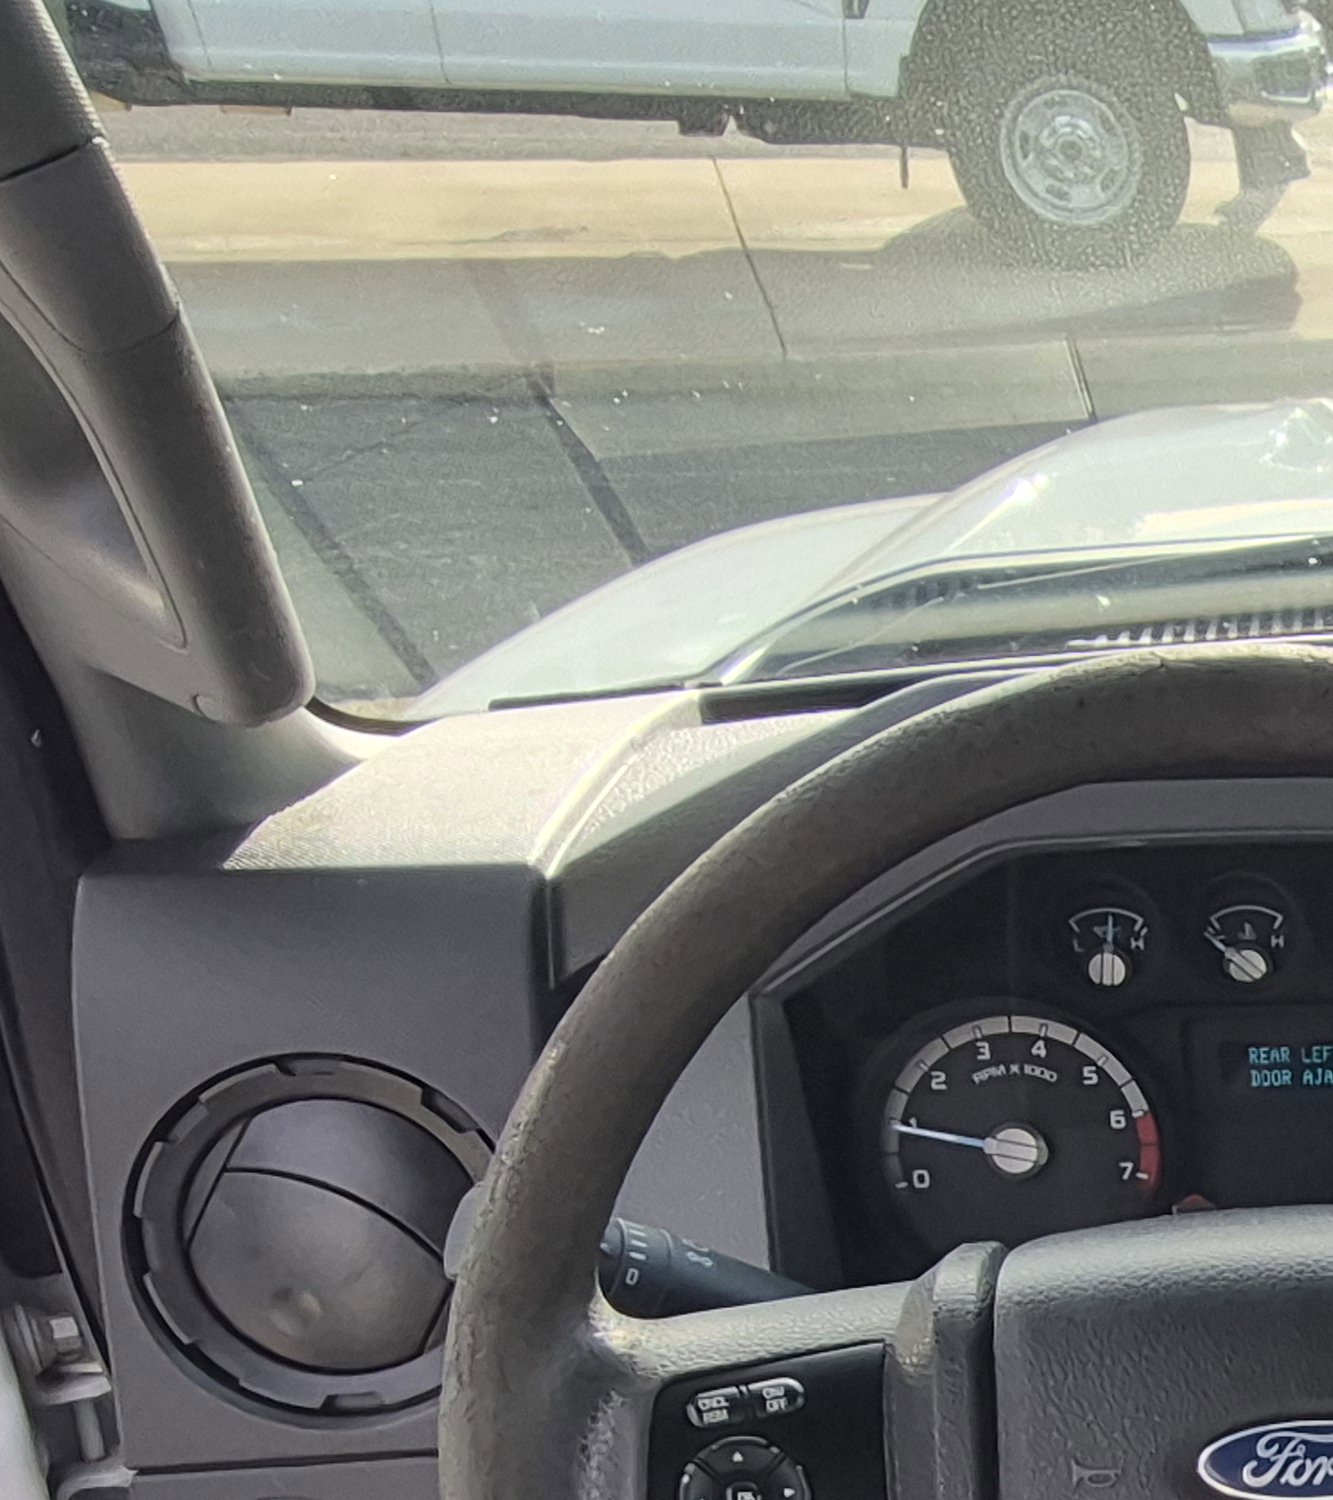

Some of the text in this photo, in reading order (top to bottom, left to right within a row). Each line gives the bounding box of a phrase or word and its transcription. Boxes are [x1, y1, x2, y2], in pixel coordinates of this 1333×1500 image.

[1131, 937, 1145, 950] H
[1271, 935, 1284, 948] H
[977, 1042, 991, 1060] 3
[1031, 1041, 1047, 1058] 4
[1248, 1047, 1291, 1064] REAR
[931, 1072, 947, 1090] 2
[972, 1064, 1006, 1085] RPM
[1023, 1063, 1057, 1083] 1000
[1083, 1067, 1099, 1085] 5
[1250, 1069, 1292, 1087] DOOR
[1110, 1110, 1127, 1129] 6
[913, 1170, 930, 1189] 0
[1119, 1163, 1135, 1180] 7
